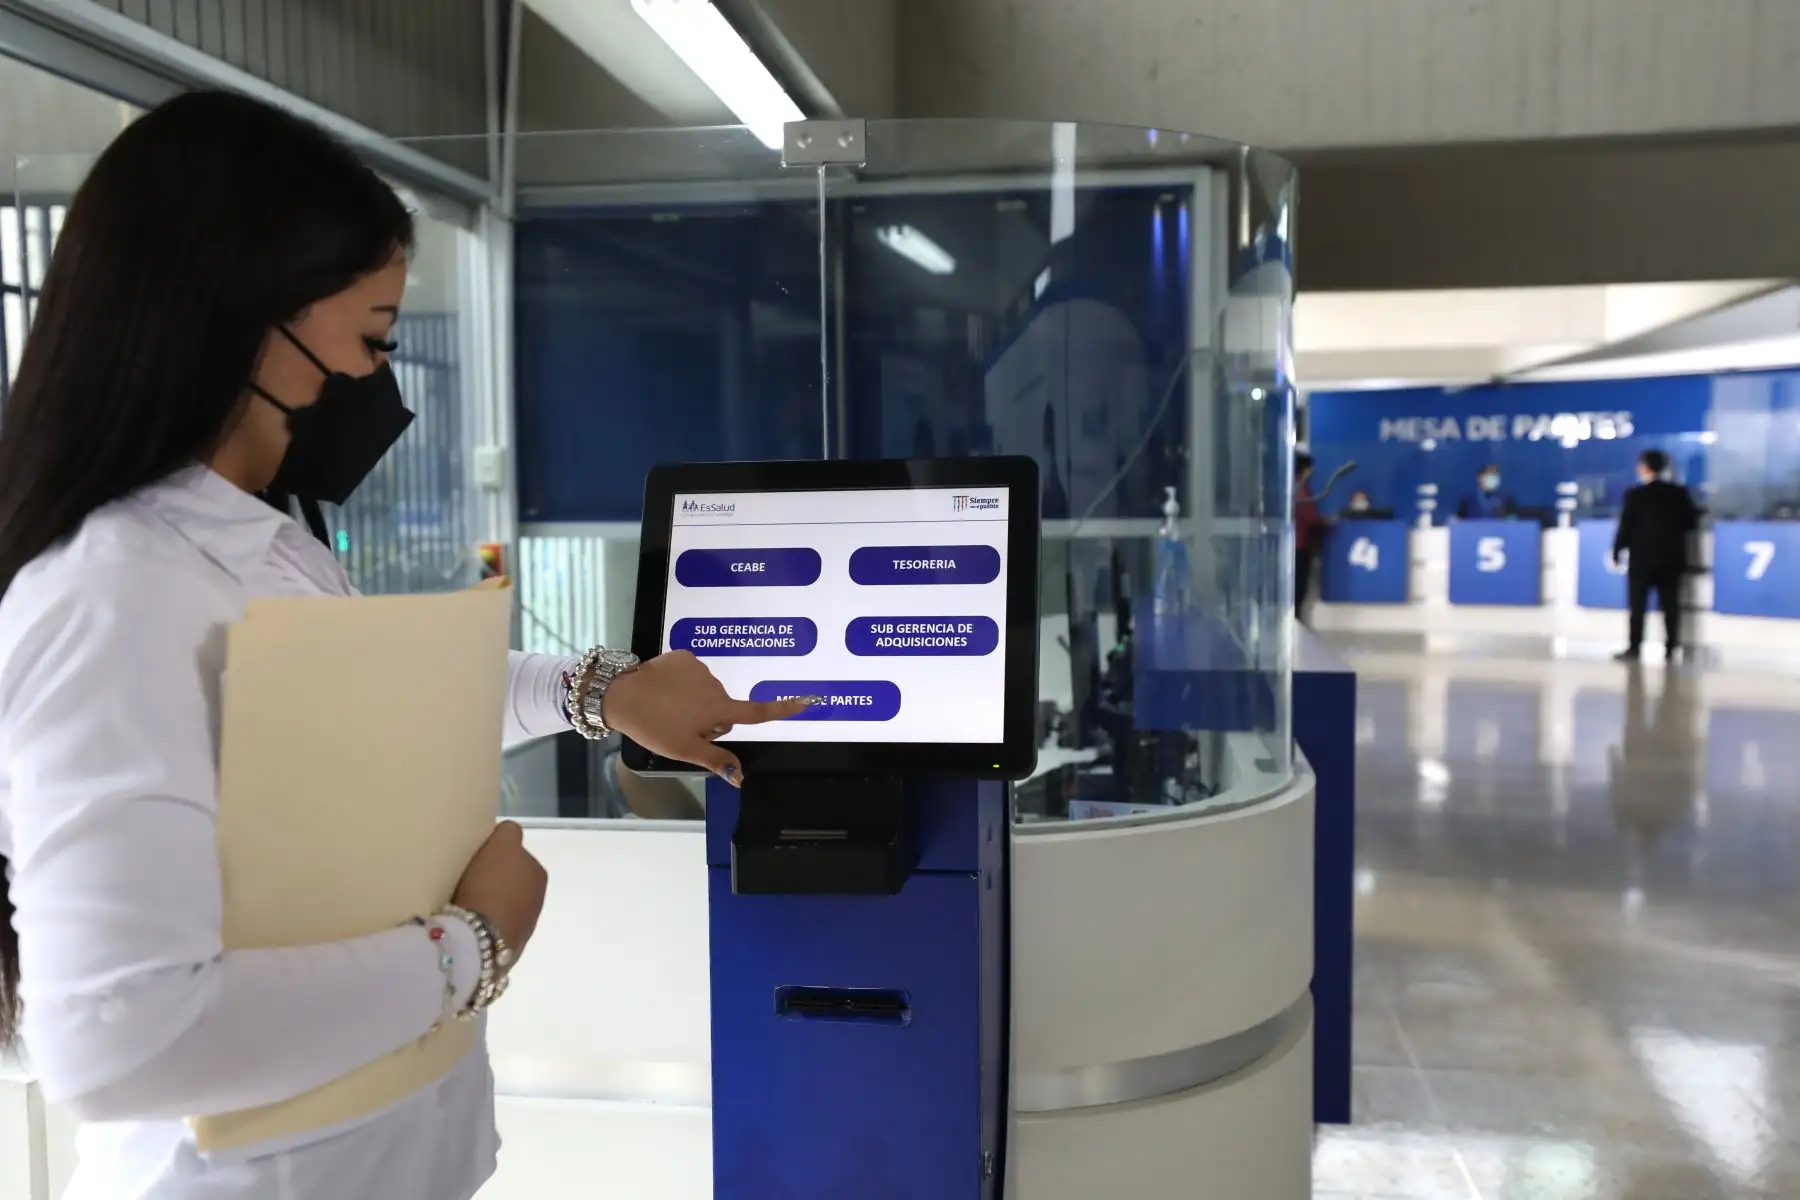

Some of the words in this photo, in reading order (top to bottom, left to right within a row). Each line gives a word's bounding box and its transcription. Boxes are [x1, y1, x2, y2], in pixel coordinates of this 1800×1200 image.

[1379, 415, 1461, 442] MESA
[1466, 414, 1507, 441] DE
[700, 503, 736, 512] EsSalud
[1348, 537, 1379, 572] 4
[1476, 536, 1506, 572] 5
[892, 559, 956, 570] TESORERIA
[1742, 541, 1775, 580] 7
[730, 562, 766, 573] CEABE
[694, 625, 717, 635] SUB
[719, 625, 776, 635] GERENCIA
[779, 624, 793, 635] DE
[870, 623, 894, 634] SUB
[896, 623, 955, 634] GERENCIA
[957, 623, 973, 634] DE
[690, 637, 796, 648] COMPENSACIONES
[875, 636, 967, 648] ADQUISICIONES
[830, 695, 873, 706] PARTES
